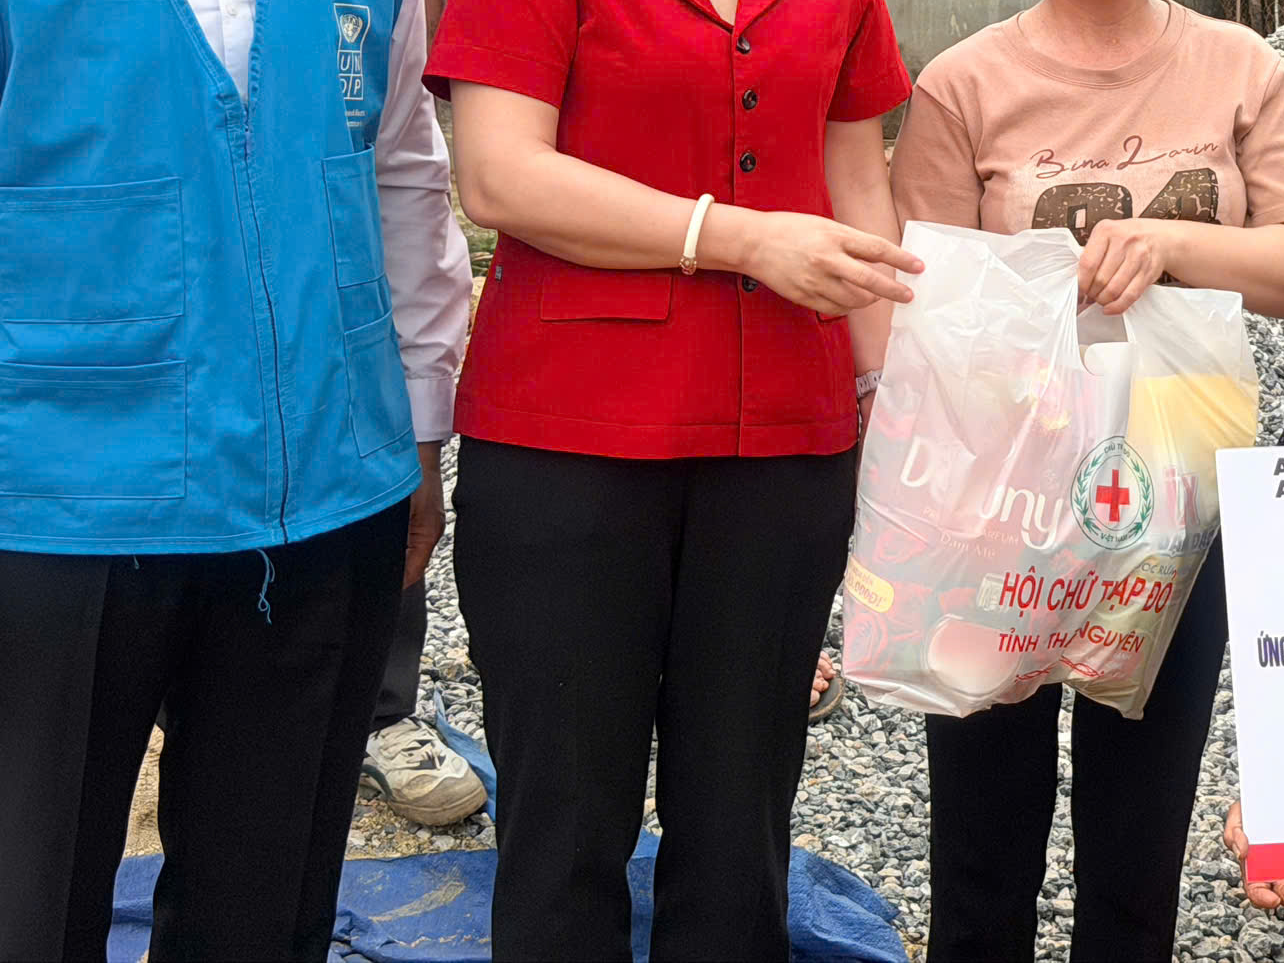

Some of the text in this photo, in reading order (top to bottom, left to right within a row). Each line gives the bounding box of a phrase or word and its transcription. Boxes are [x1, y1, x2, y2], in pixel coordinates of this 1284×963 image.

[1000, 566, 1044, 618] HỘI
[1047, 572, 1099, 611] CHỮ
[999, 627, 1040, 653] TỈNH
